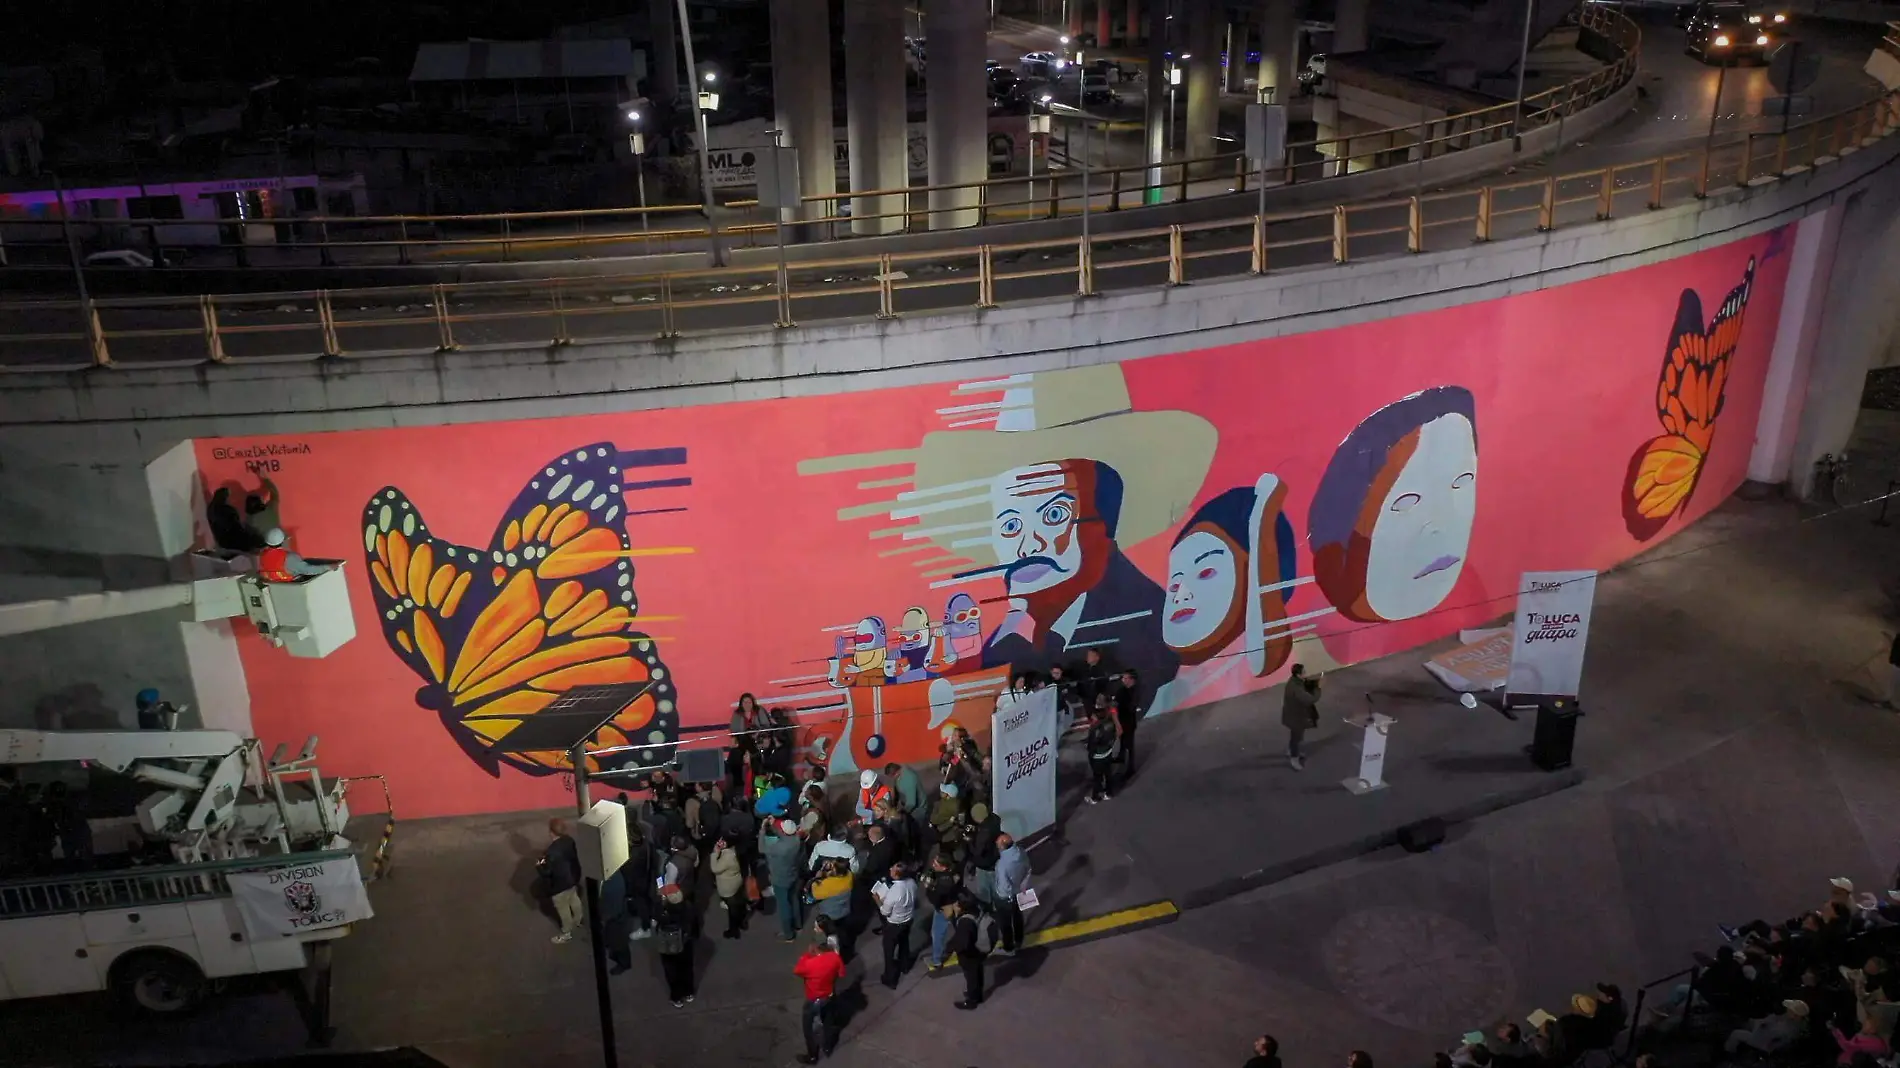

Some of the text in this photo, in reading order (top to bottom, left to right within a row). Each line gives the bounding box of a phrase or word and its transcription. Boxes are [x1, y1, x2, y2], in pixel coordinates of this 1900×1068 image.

[1527, 613, 1580, 625] TOLUCA
[1525, 628, 1577, 643] guapa
[1004, 736, 1050, 768] TOLUCA
[1006, 753, 1049, 790] guapa
[268, 865, 324, 884] DIVISION
